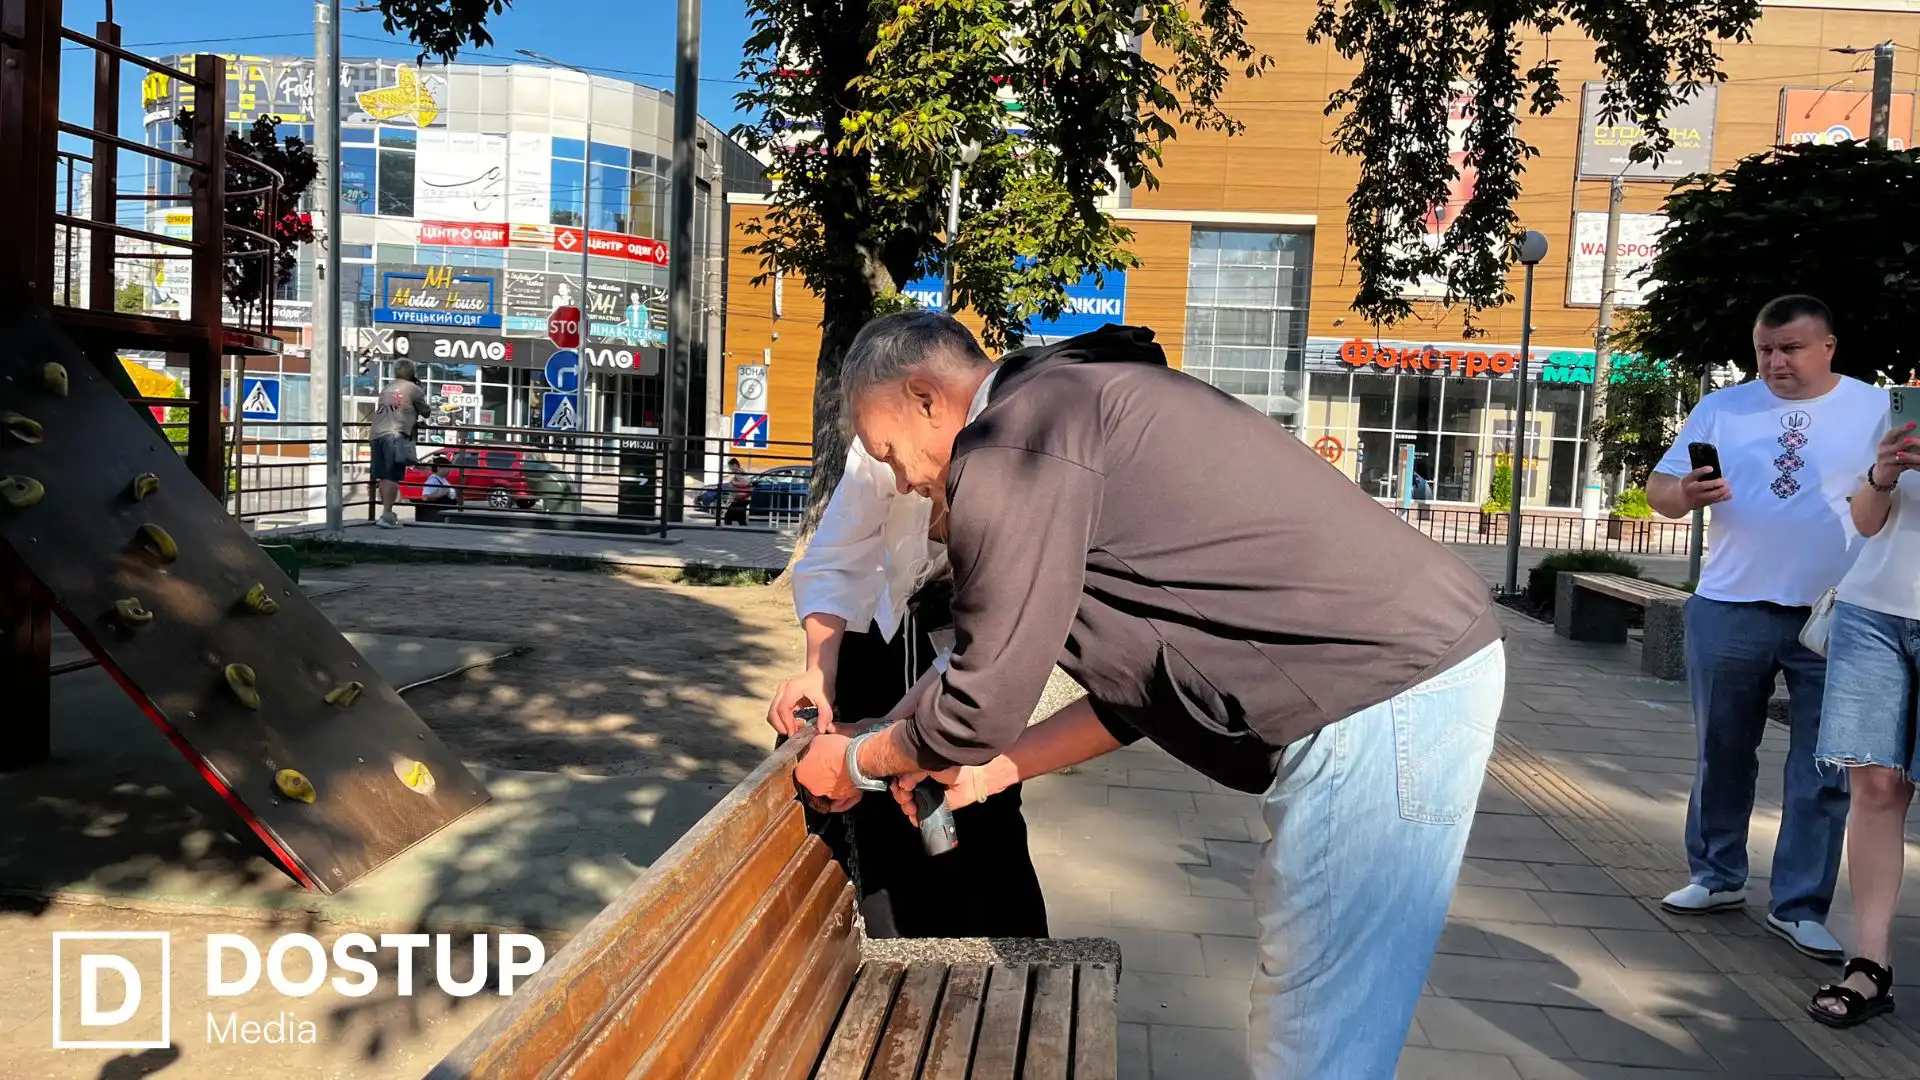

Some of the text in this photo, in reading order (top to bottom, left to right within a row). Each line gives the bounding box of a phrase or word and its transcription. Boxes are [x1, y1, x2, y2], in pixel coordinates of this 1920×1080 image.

[390, 288, 485, 311] Moda House
[391, 311, 483, 327] ТУРЕЦЬКИЙ ОДЯГ
[550, 320, 578, 335] STO
[739, 367, 765, 377] ЗОНА
[452, 395, 479, 404] СТОП
